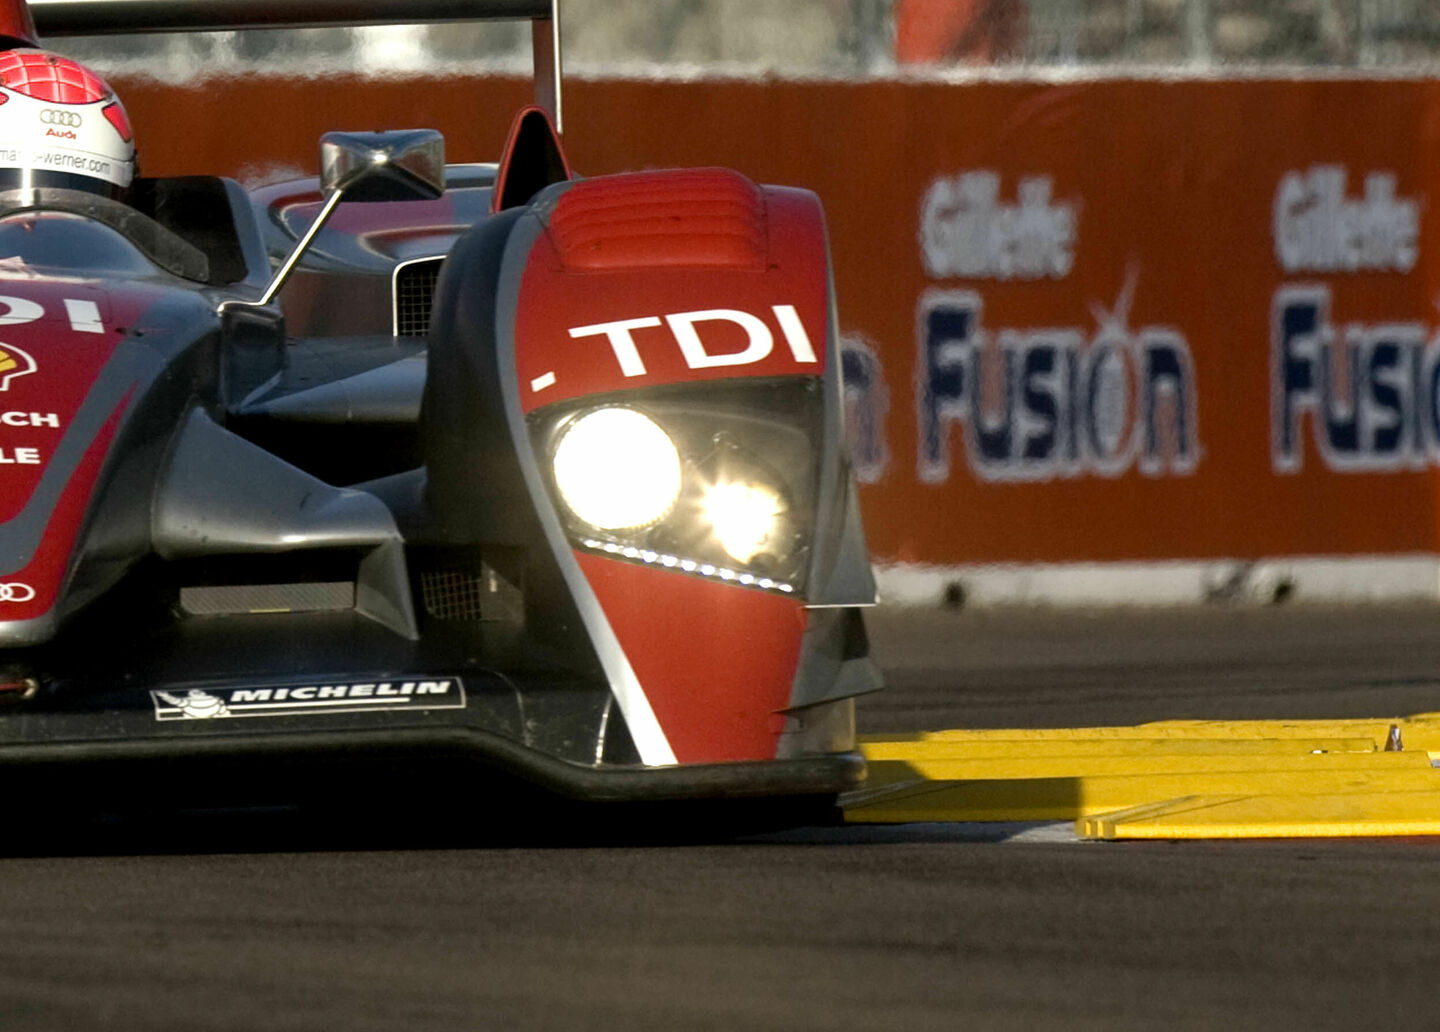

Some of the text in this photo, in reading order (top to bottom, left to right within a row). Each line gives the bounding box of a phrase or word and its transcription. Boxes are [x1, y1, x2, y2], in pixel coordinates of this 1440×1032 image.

[45, 128, 77, 140] Audi
[568, 305, 817, 377] TDI
[918, 288, 1199, 482] Fusion
[230, 681, 451, 702] MICHELIN
